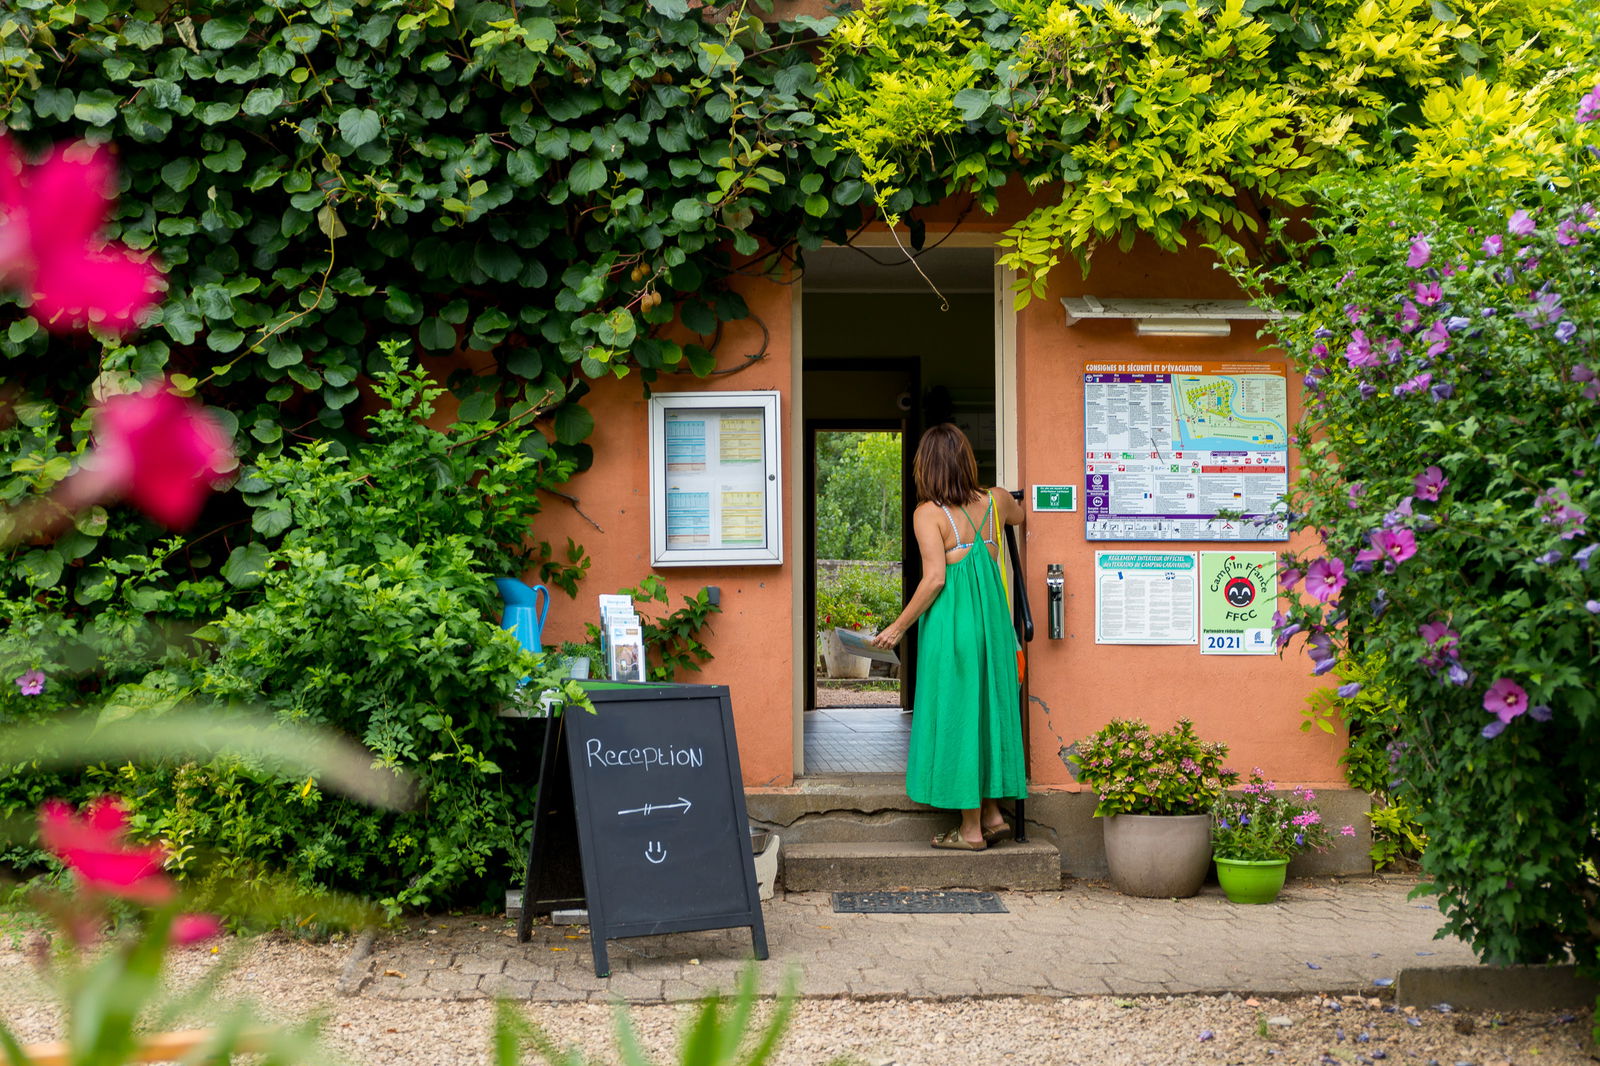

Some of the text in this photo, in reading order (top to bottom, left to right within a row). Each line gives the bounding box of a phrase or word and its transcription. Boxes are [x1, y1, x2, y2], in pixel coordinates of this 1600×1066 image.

[1085, 364, 1117, 372] CONSIGNES
[1118, 364, 1125, 372] DE
[1127, 363, 1152, 372] SÉCURITÉ
[1161, 363, 1203, 373] D'ÉVACUATION
[1245, 562, 1267, 593] France
[1225, 609, 1257, 622] FFCC
[1207, 636, 1240, 649] 2021
